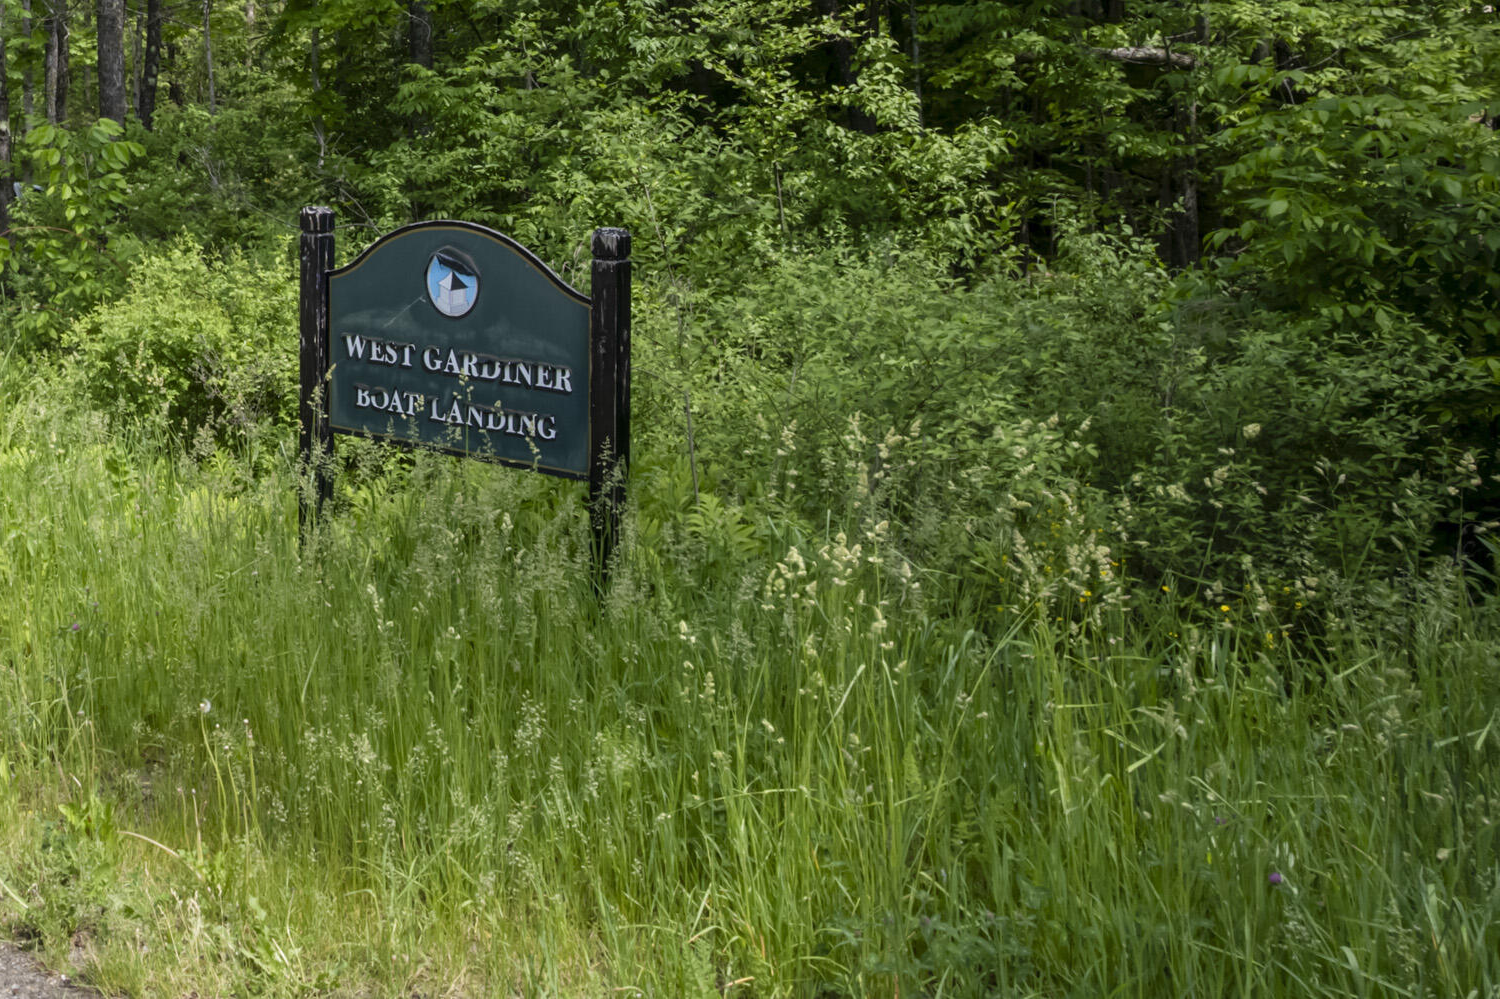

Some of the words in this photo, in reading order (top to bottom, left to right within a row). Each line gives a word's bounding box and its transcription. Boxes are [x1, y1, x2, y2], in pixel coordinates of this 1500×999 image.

[342, 333, 416, 367] WEST
[423, 346, 572, 392] GARDINER
[355, 384, 420, 416] BOAT
[428, 395, 556, 439] LANDING
